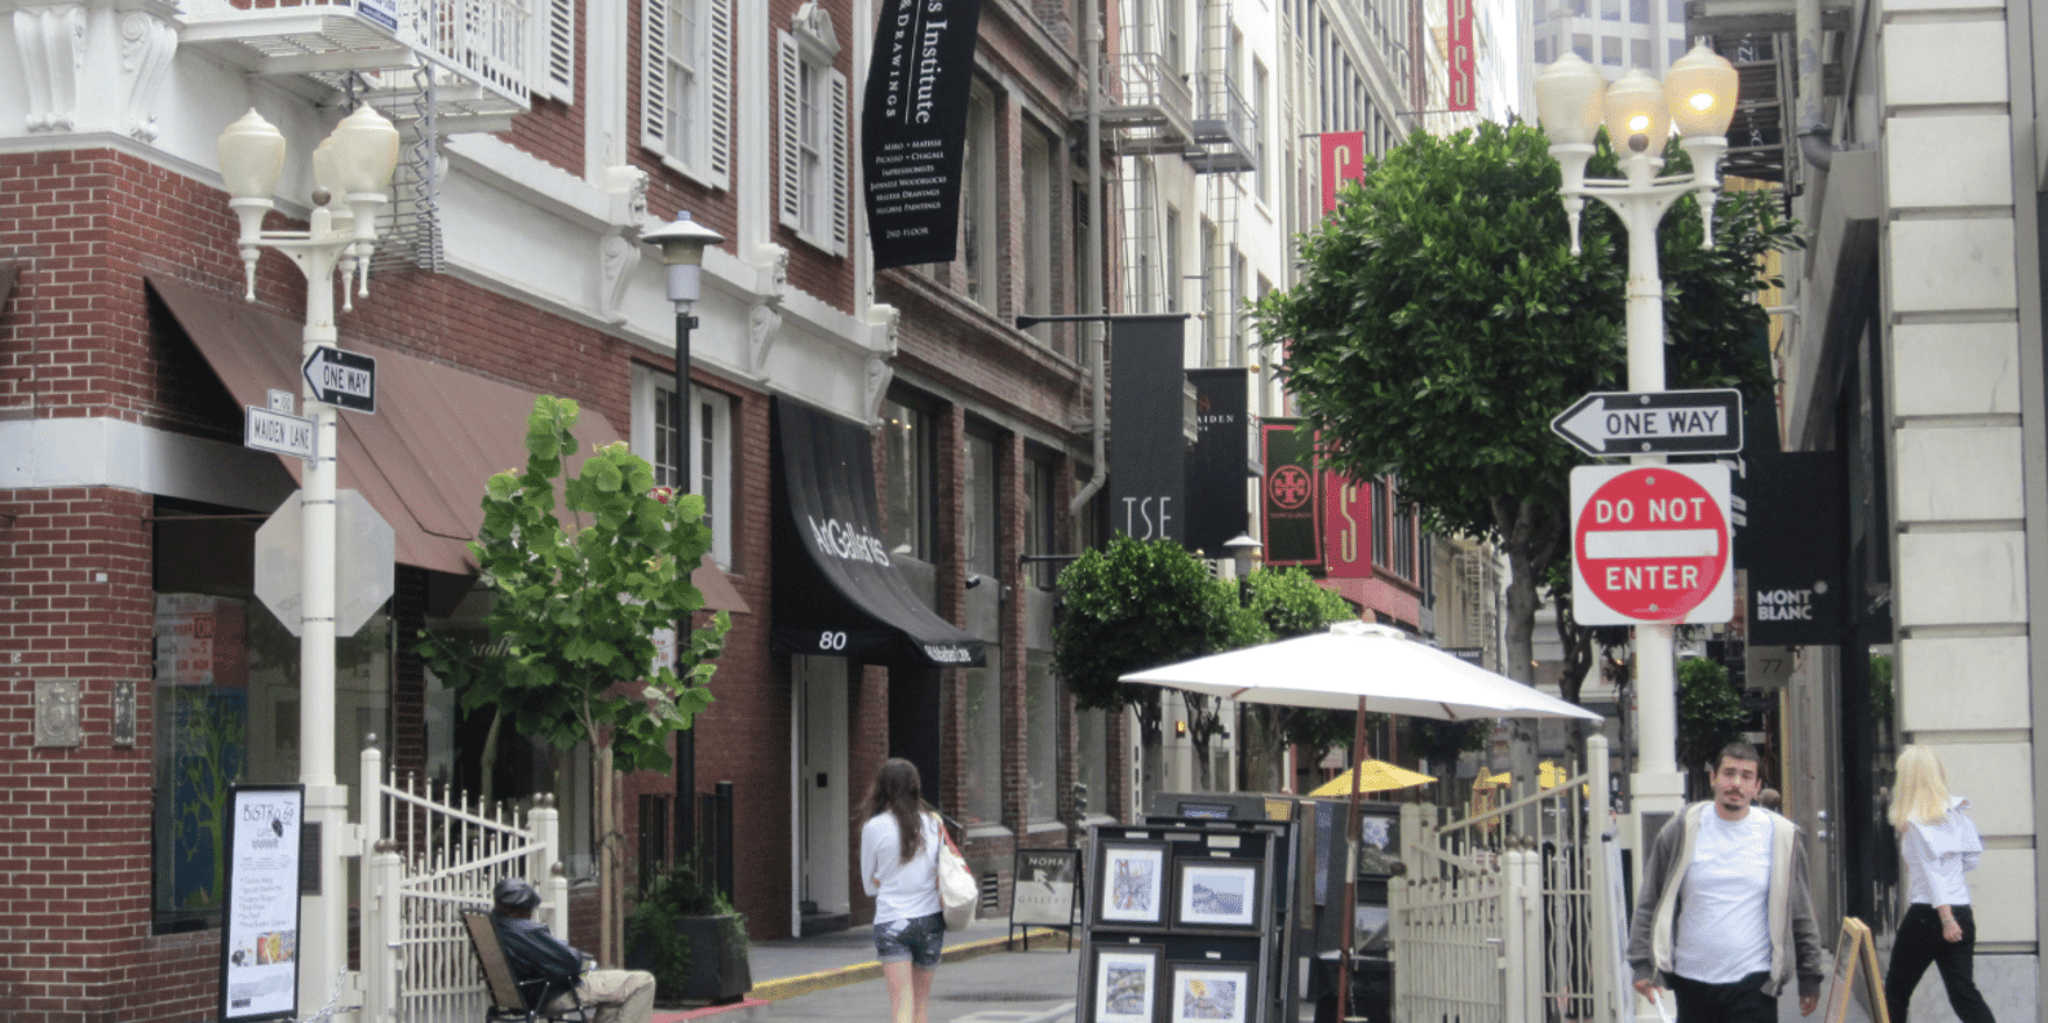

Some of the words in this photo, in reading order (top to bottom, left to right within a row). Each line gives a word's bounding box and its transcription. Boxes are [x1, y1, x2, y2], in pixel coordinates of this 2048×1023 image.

[886, 13, 910, 118] DRAWINGS
[915, 19, 948, 124] Institute
[323, 365, 345, 389] ONE
[348, 371, 367, 394] WAY
[1197, 414, 1235, 424] AIDEN
[1606, 412, 1658, 435] ONE
[1668, 410, 1719, 433] WAY
[254, 416, 285, 445] MAIDEN
[290, 425, 310, 450] LANE
[1122, 496, 1171, 541] TSE
[1595, 498, 1634, 523] DO
[1649, 497, 1706, 523] NOT
[1606, 565, 1698, 591] ENTER
[1757, 589, 1812, 605] MONT
[1757, 605, 1813, 621] BLANC
[819, 631, 847, 650] 80
[1760, 659, 1783, 674] 77
[1028, 857, 1064, 867] NOMA
